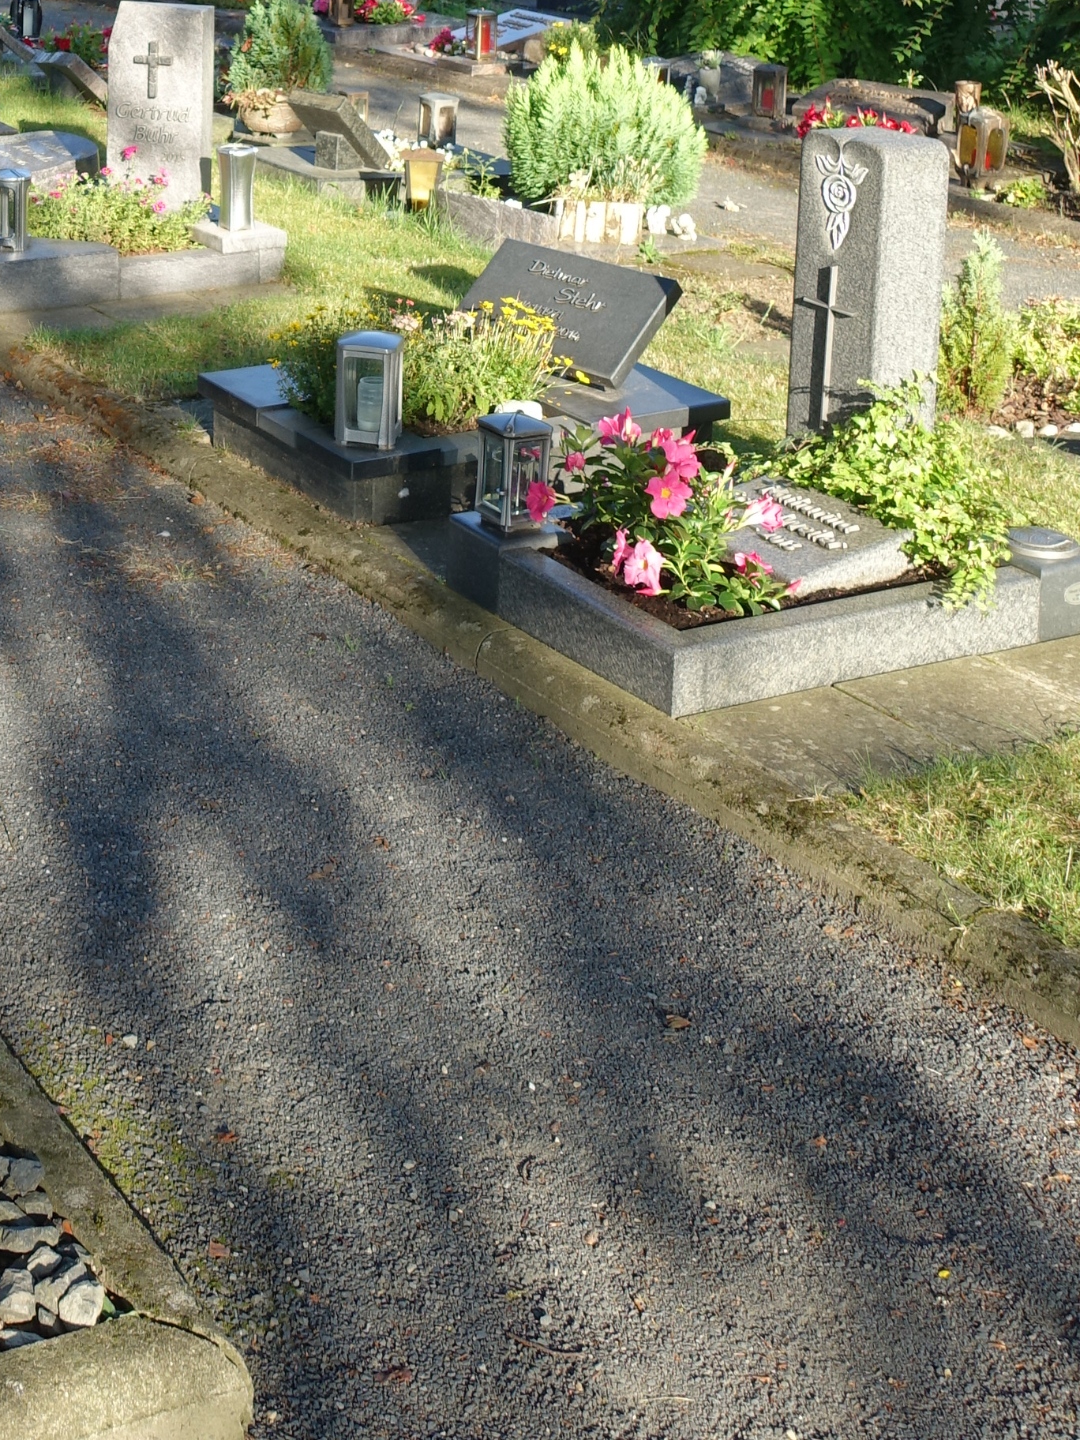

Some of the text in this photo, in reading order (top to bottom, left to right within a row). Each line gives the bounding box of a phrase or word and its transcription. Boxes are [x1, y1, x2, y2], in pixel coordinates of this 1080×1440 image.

[115, 101, 191, 123] Gertrud
[528, 259, 591, 287] Dietmar
[554, 287, 608, 312] Stehr
